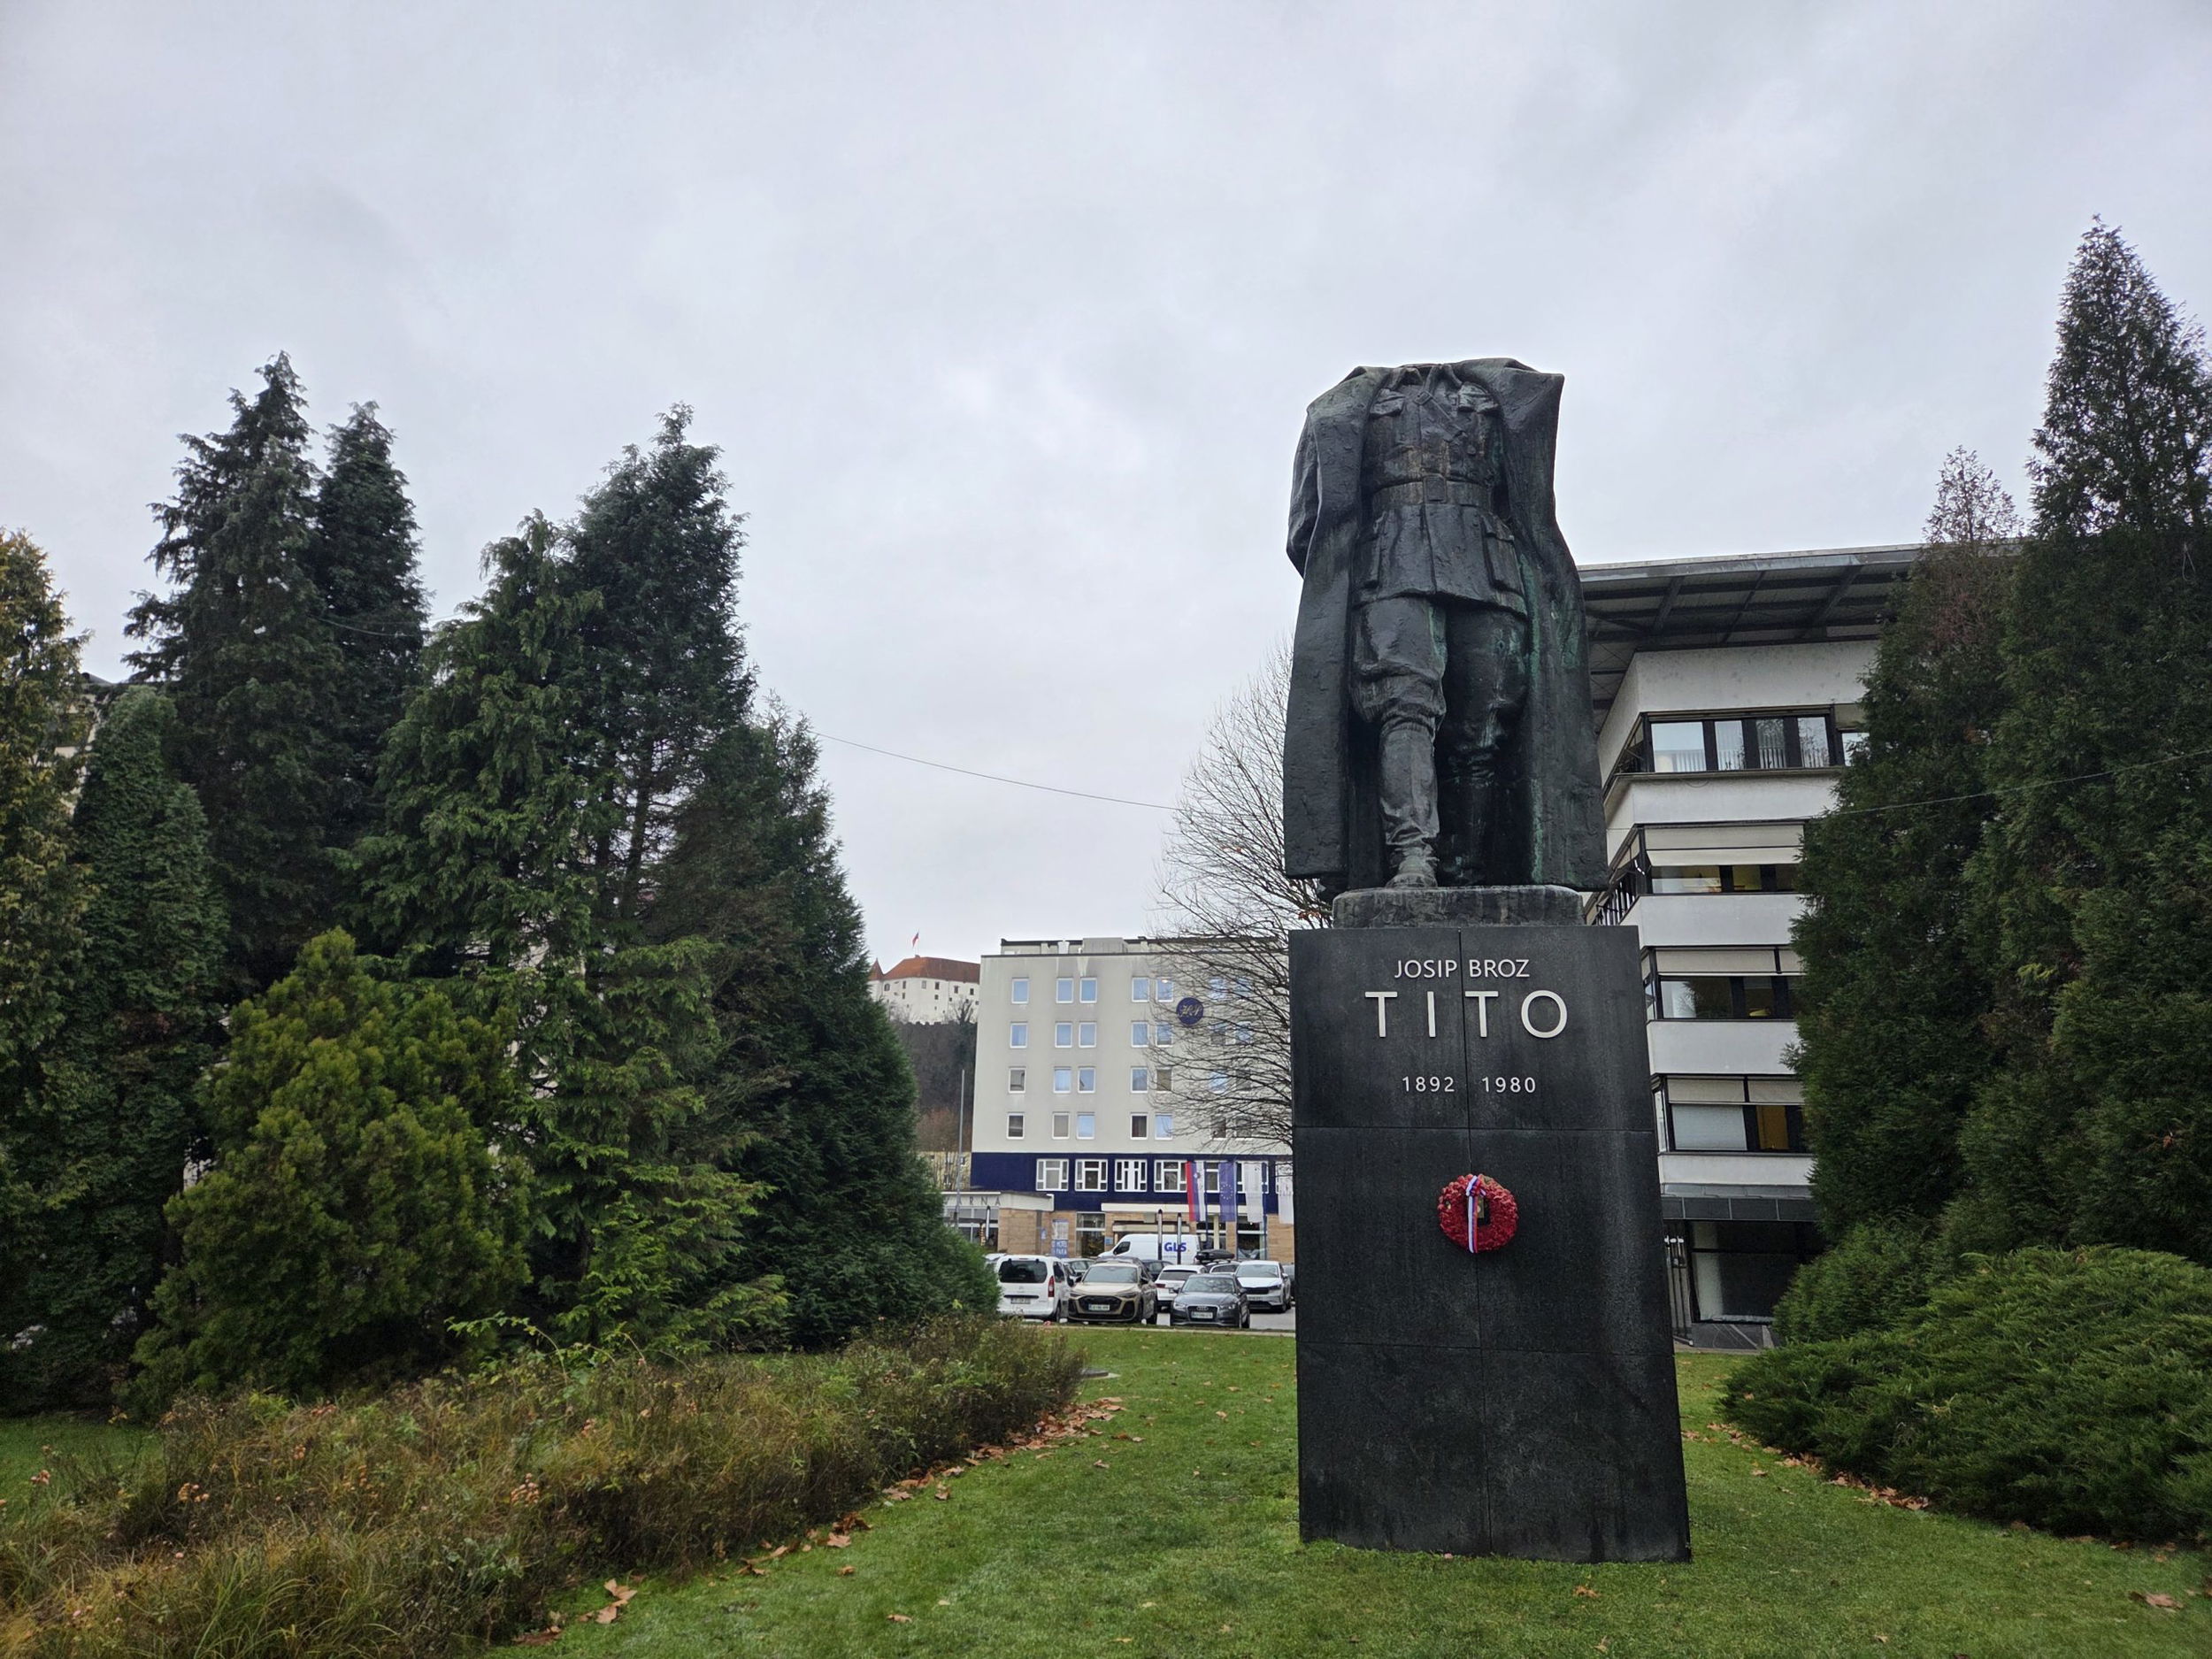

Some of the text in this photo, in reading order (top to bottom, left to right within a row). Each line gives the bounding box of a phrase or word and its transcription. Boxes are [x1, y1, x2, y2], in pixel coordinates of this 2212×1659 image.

[1394, 958, 1531, 979] JOSIP BROZ
[1364, 989, 1568, 1039] TITO
[1402, 1076, 1537, 1094] 1892 1980
[1164, 1241, 1187, 1252] GLS
